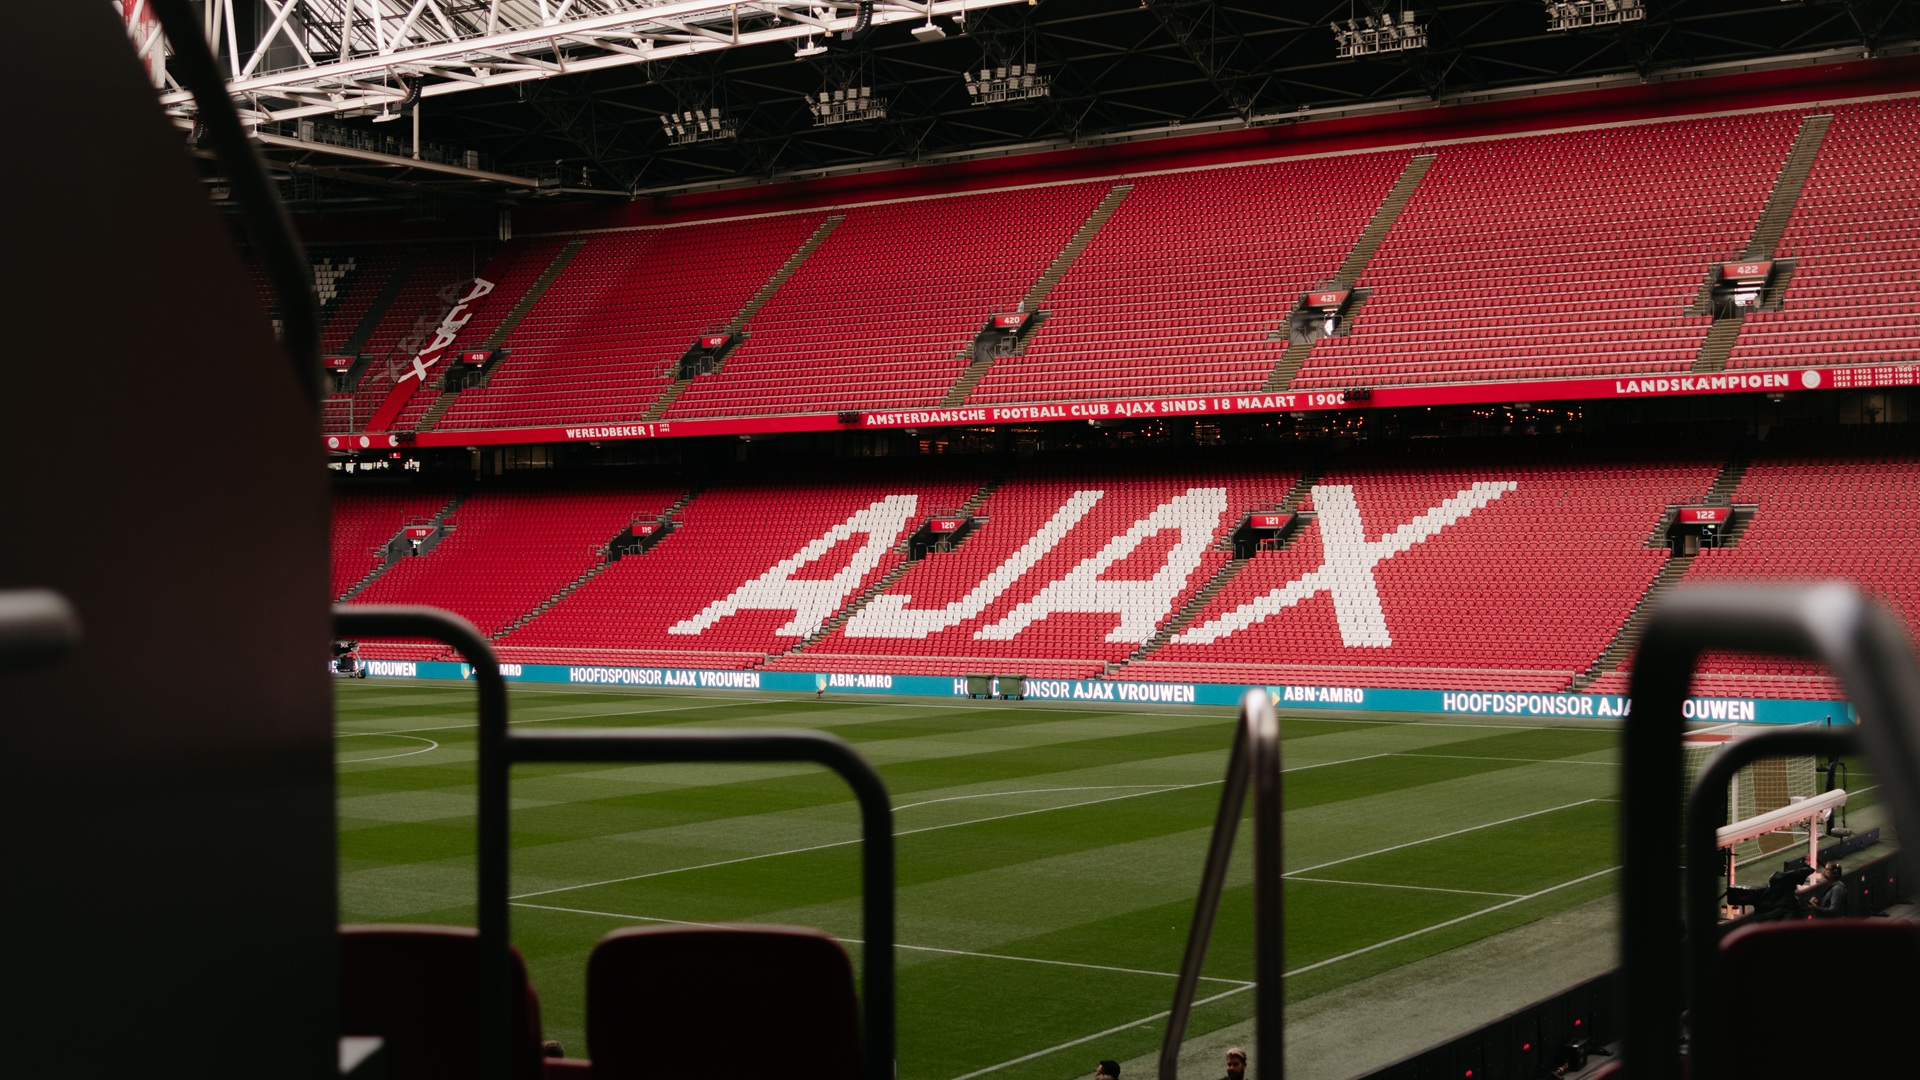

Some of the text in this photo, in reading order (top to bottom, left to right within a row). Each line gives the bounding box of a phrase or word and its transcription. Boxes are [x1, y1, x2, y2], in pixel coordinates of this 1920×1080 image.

[1737, 265, 1759, 275] 422
[1320, 294, 1337, 303] 421
[1004, 316, 1020, 325] 420
[397, 277, 495, 383] AJAX
[471, 353, 484, 361] 418
[1616, 373, 1789, 394] LANDSKAMPIOEN
[866, 393, 1346, 425] AMSTERDAMSCHE FOOTBALL CLUB AJAX SINDS 18 MAART 1900
[566, 426, 646, 439] WERELDBEKER
[1265, 516, 1279, 525] 121
[1696, 510, 1715, 520] 122
[941, 521, 956, 530] 120
[668, 480, 1519, 648] AJAX
[367, 661, 417, 676] VROUWEN
[570, 667, 760, 688] HOOFDSPONSOR AJAX VROUWEN
[1073, 682, 1114, 700] AJAX
[1117, 683, 1195, 702] VROUWEN
[1443, 692, 1593, 716] HOOFDSPONSOR
[1682, 699, 1755, 721] OUWEN
